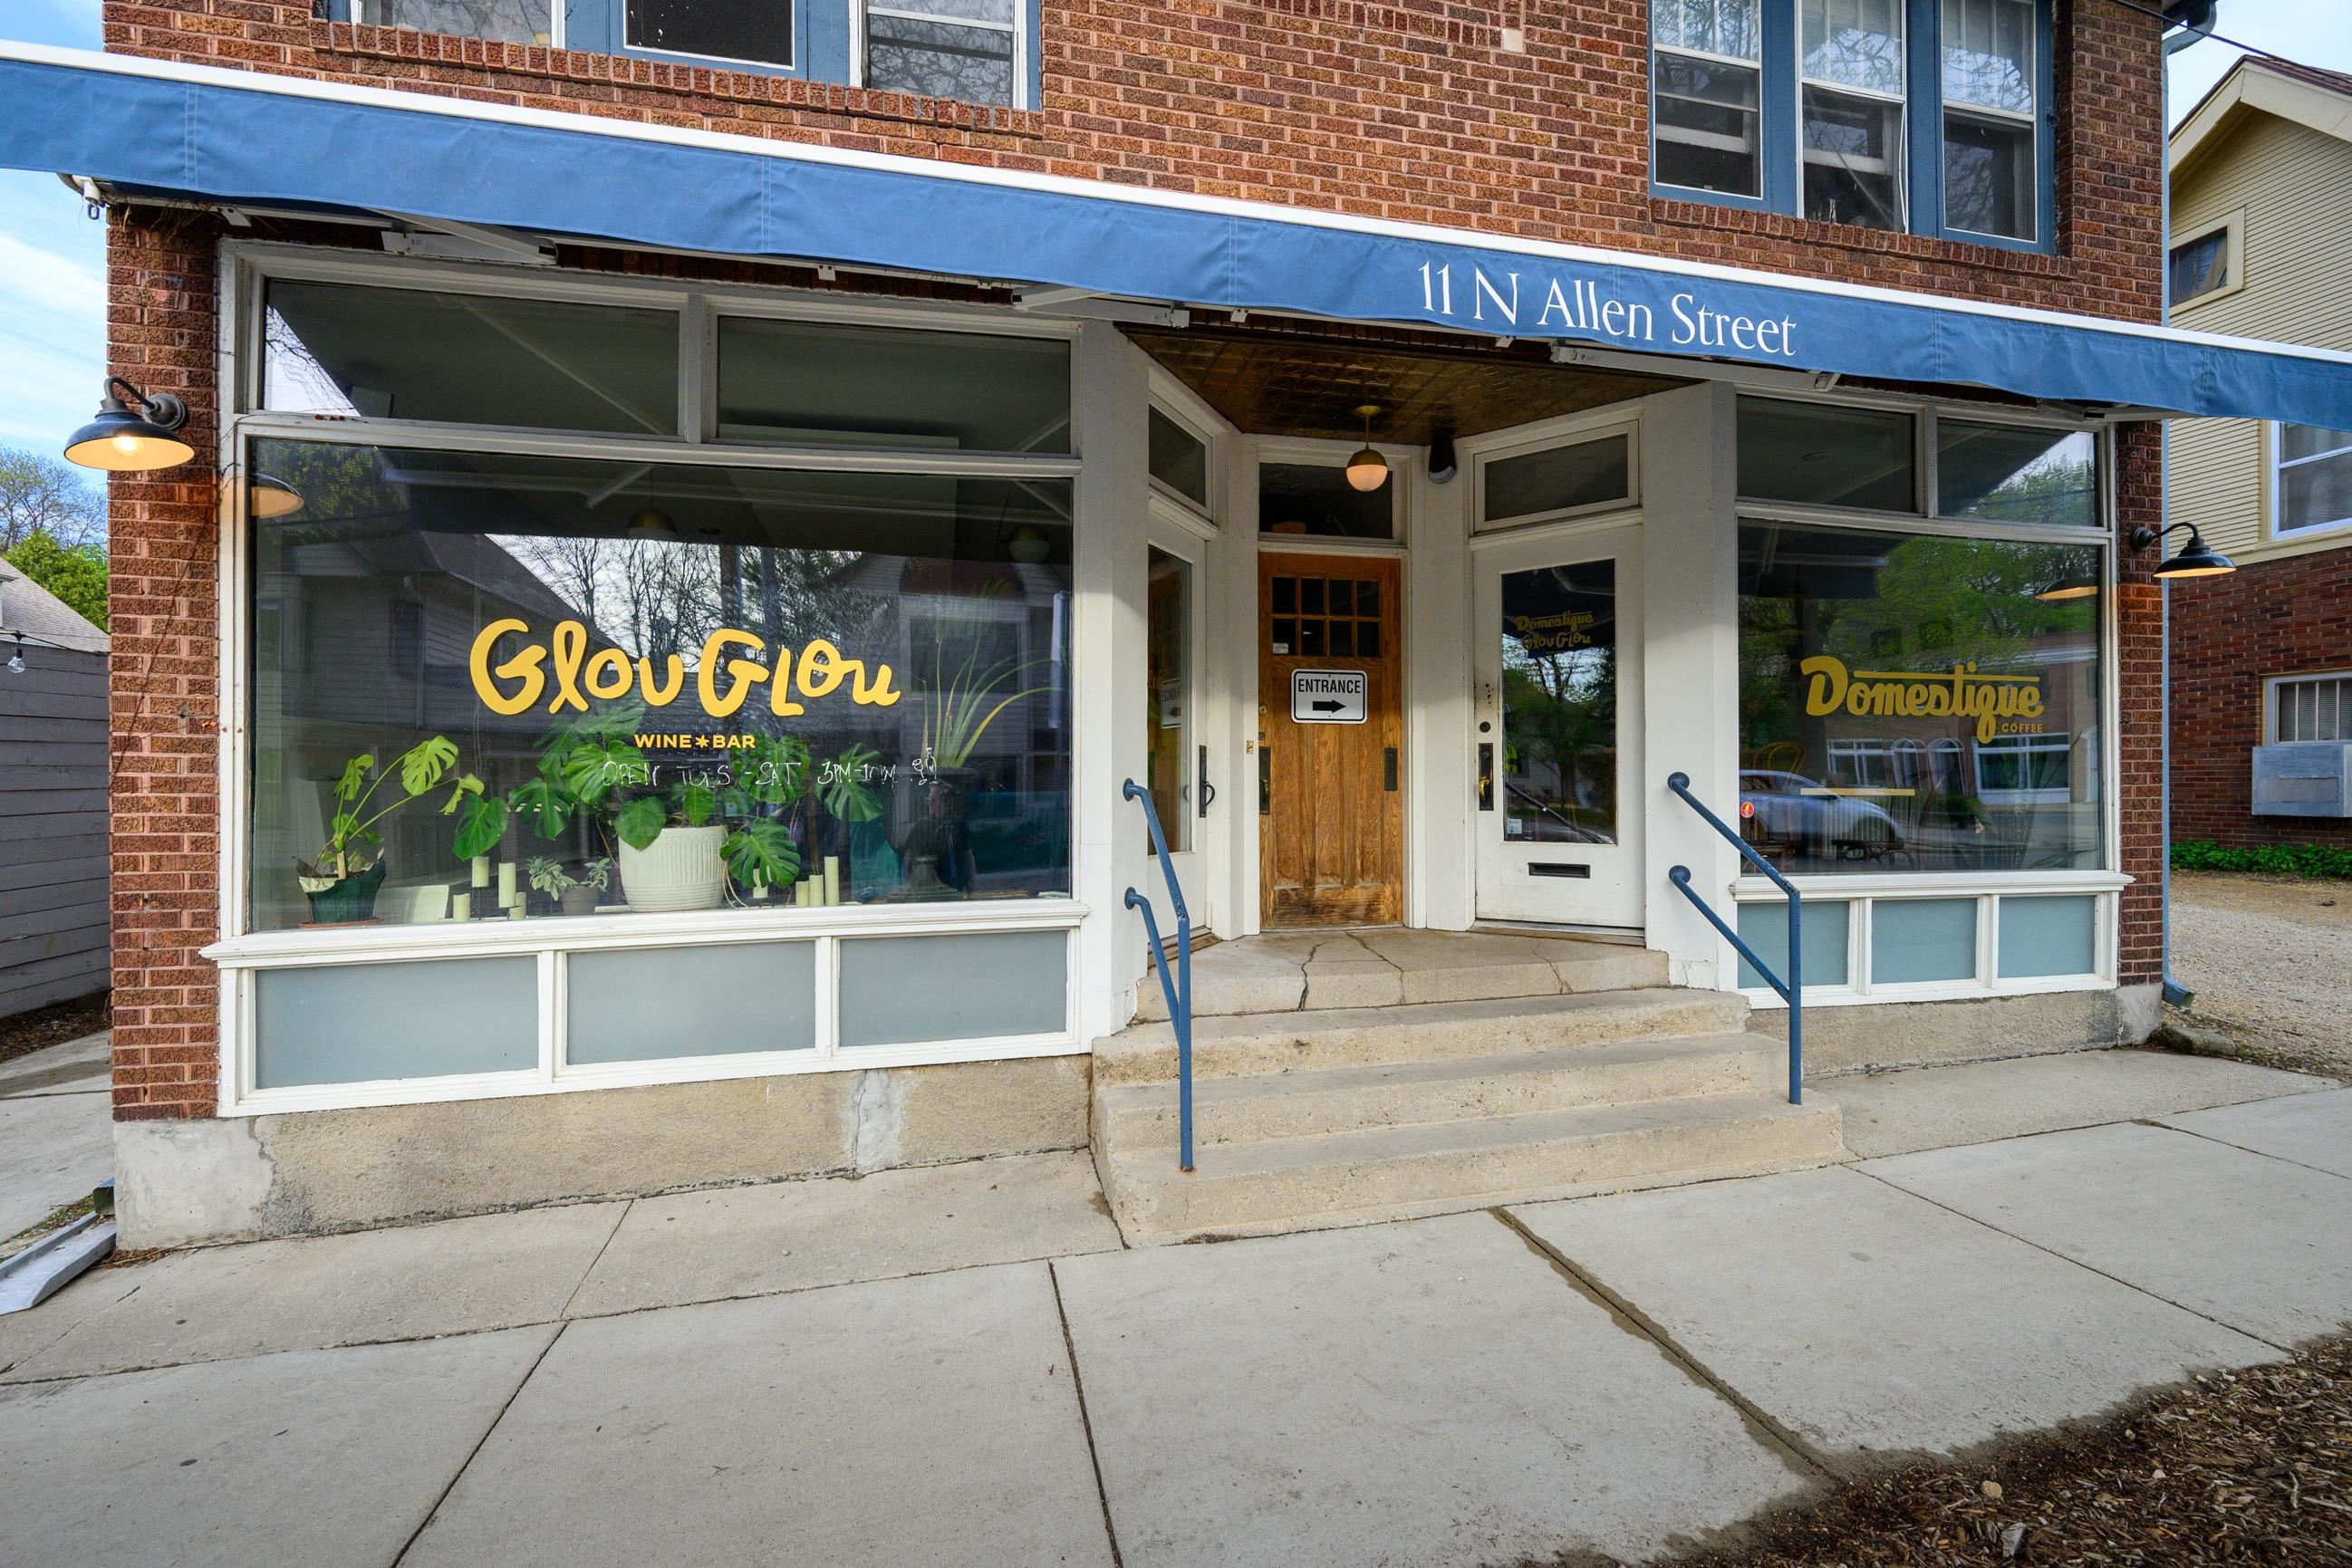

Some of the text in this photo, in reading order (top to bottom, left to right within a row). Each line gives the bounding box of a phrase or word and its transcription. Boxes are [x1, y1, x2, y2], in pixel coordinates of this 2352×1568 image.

[1419, 260, 1797, 356] 11 N Allen Street
[1514, 610, 1595, 632] Domestique
[1297, 678, 1362, 694] ENTRANCE
[1800, 656, 2045, 744] Domestique
[2000, 722, 2043, 733] COFFEE
[634, 735, 756, 748] WINE BAR
[602, 761, 660, 786] OPEN
